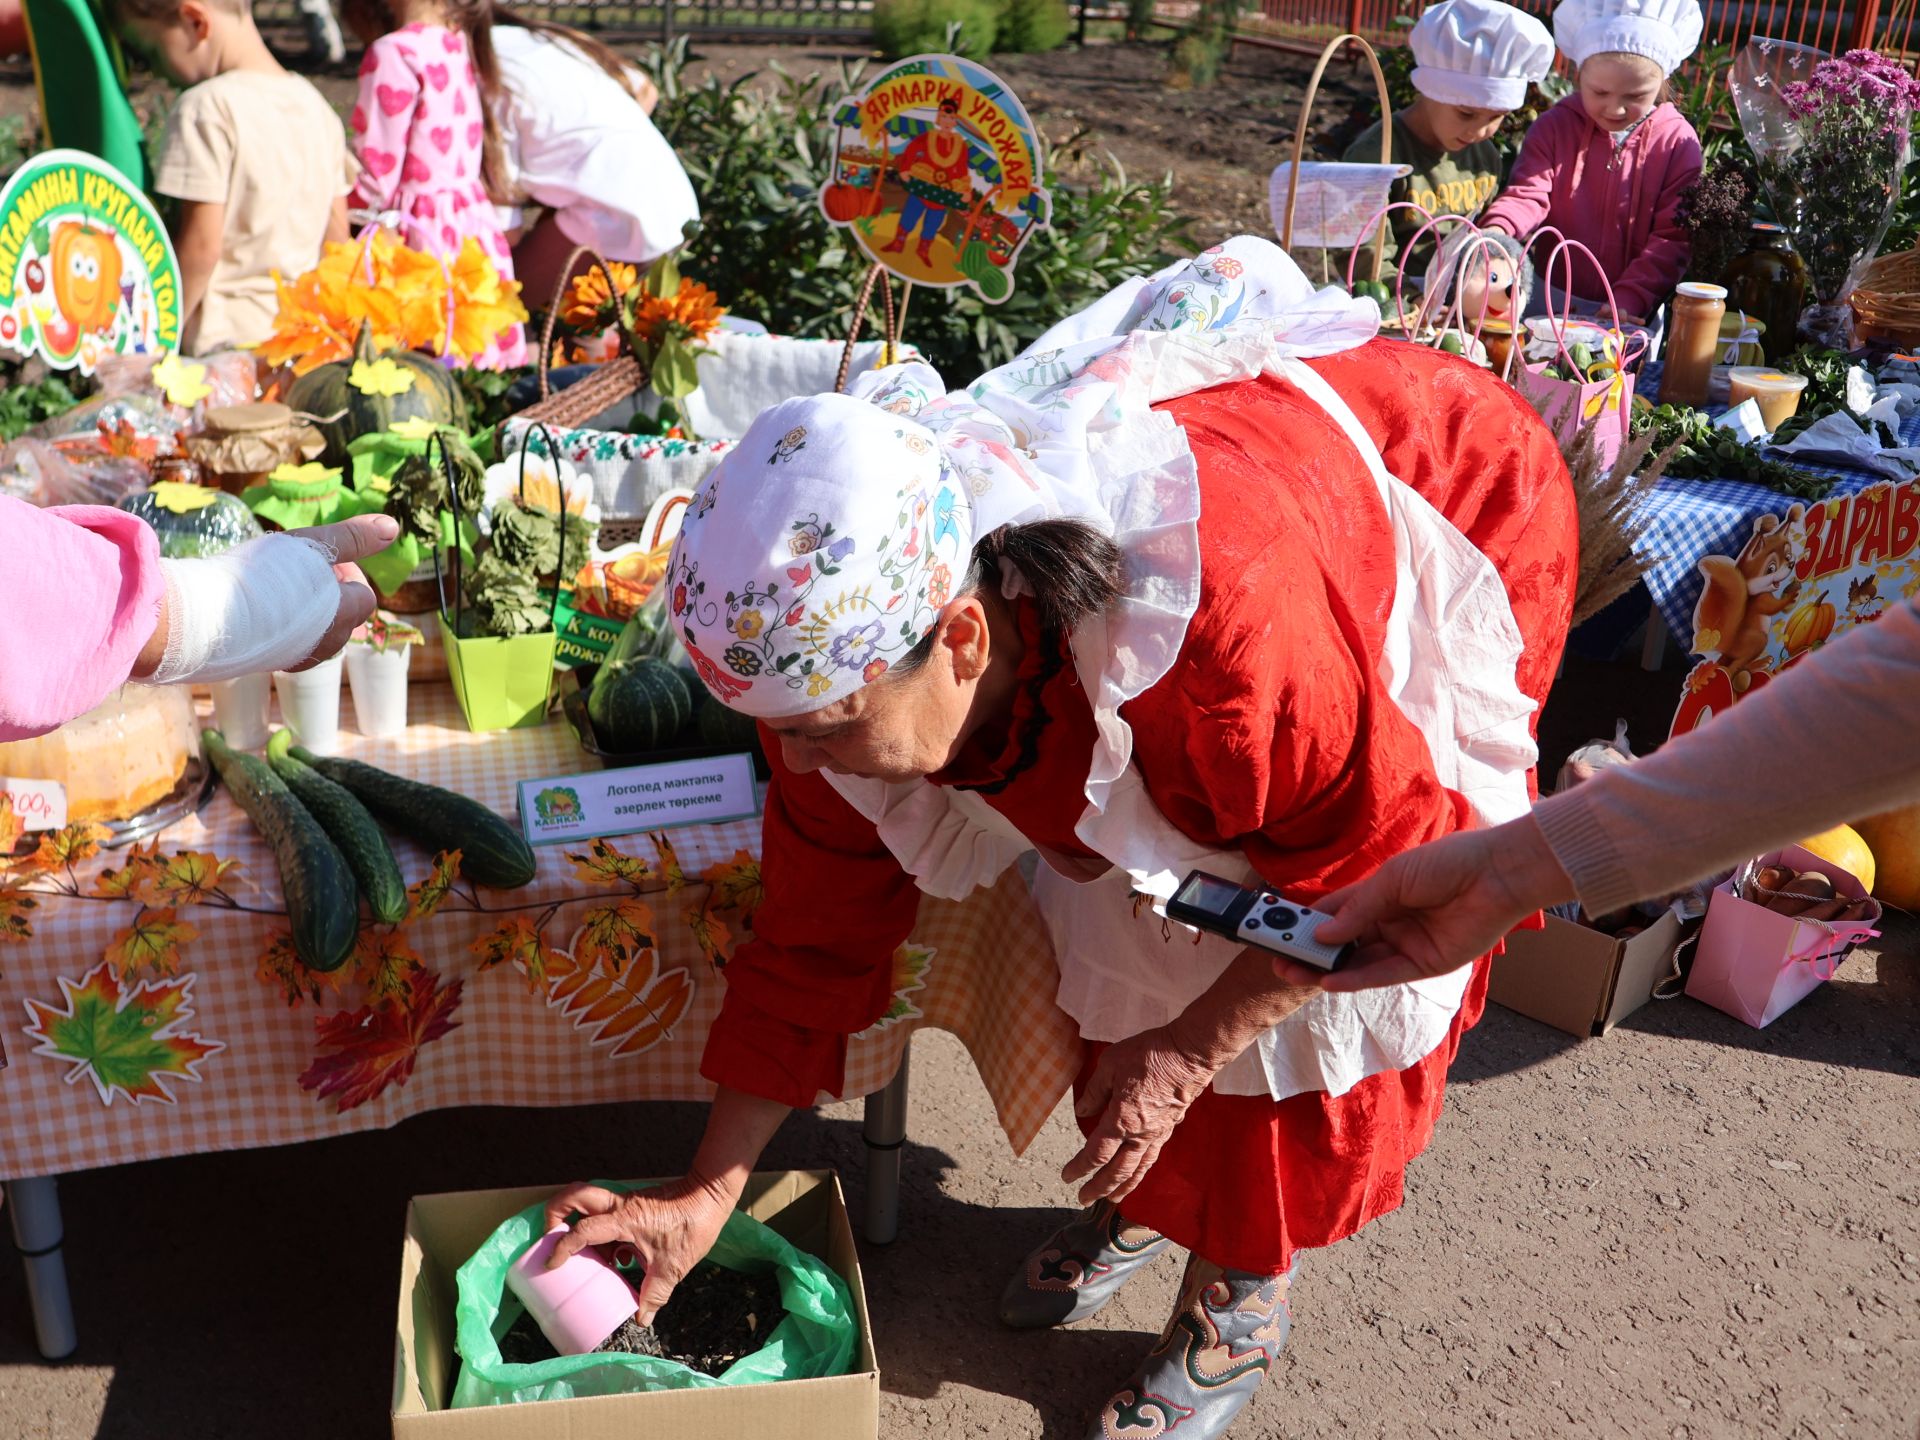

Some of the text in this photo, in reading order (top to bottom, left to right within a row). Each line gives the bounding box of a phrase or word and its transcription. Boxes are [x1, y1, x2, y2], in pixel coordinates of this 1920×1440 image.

[865, 79, 1029, 191] ЯРМАРКА УРОЖАЯ
[0, 167, 79, 298] ВИТАМИНЫ
[83, 171, 165, 272] КРУГЛЫЙ
[1794, 483, 1920, 582] ЗДРАВ
[567, 616, 582, 634] К
[607, 773, 724, 797] Логопед мәктәпкә
[614, 793, 722, 815] әзерлек төркеме
